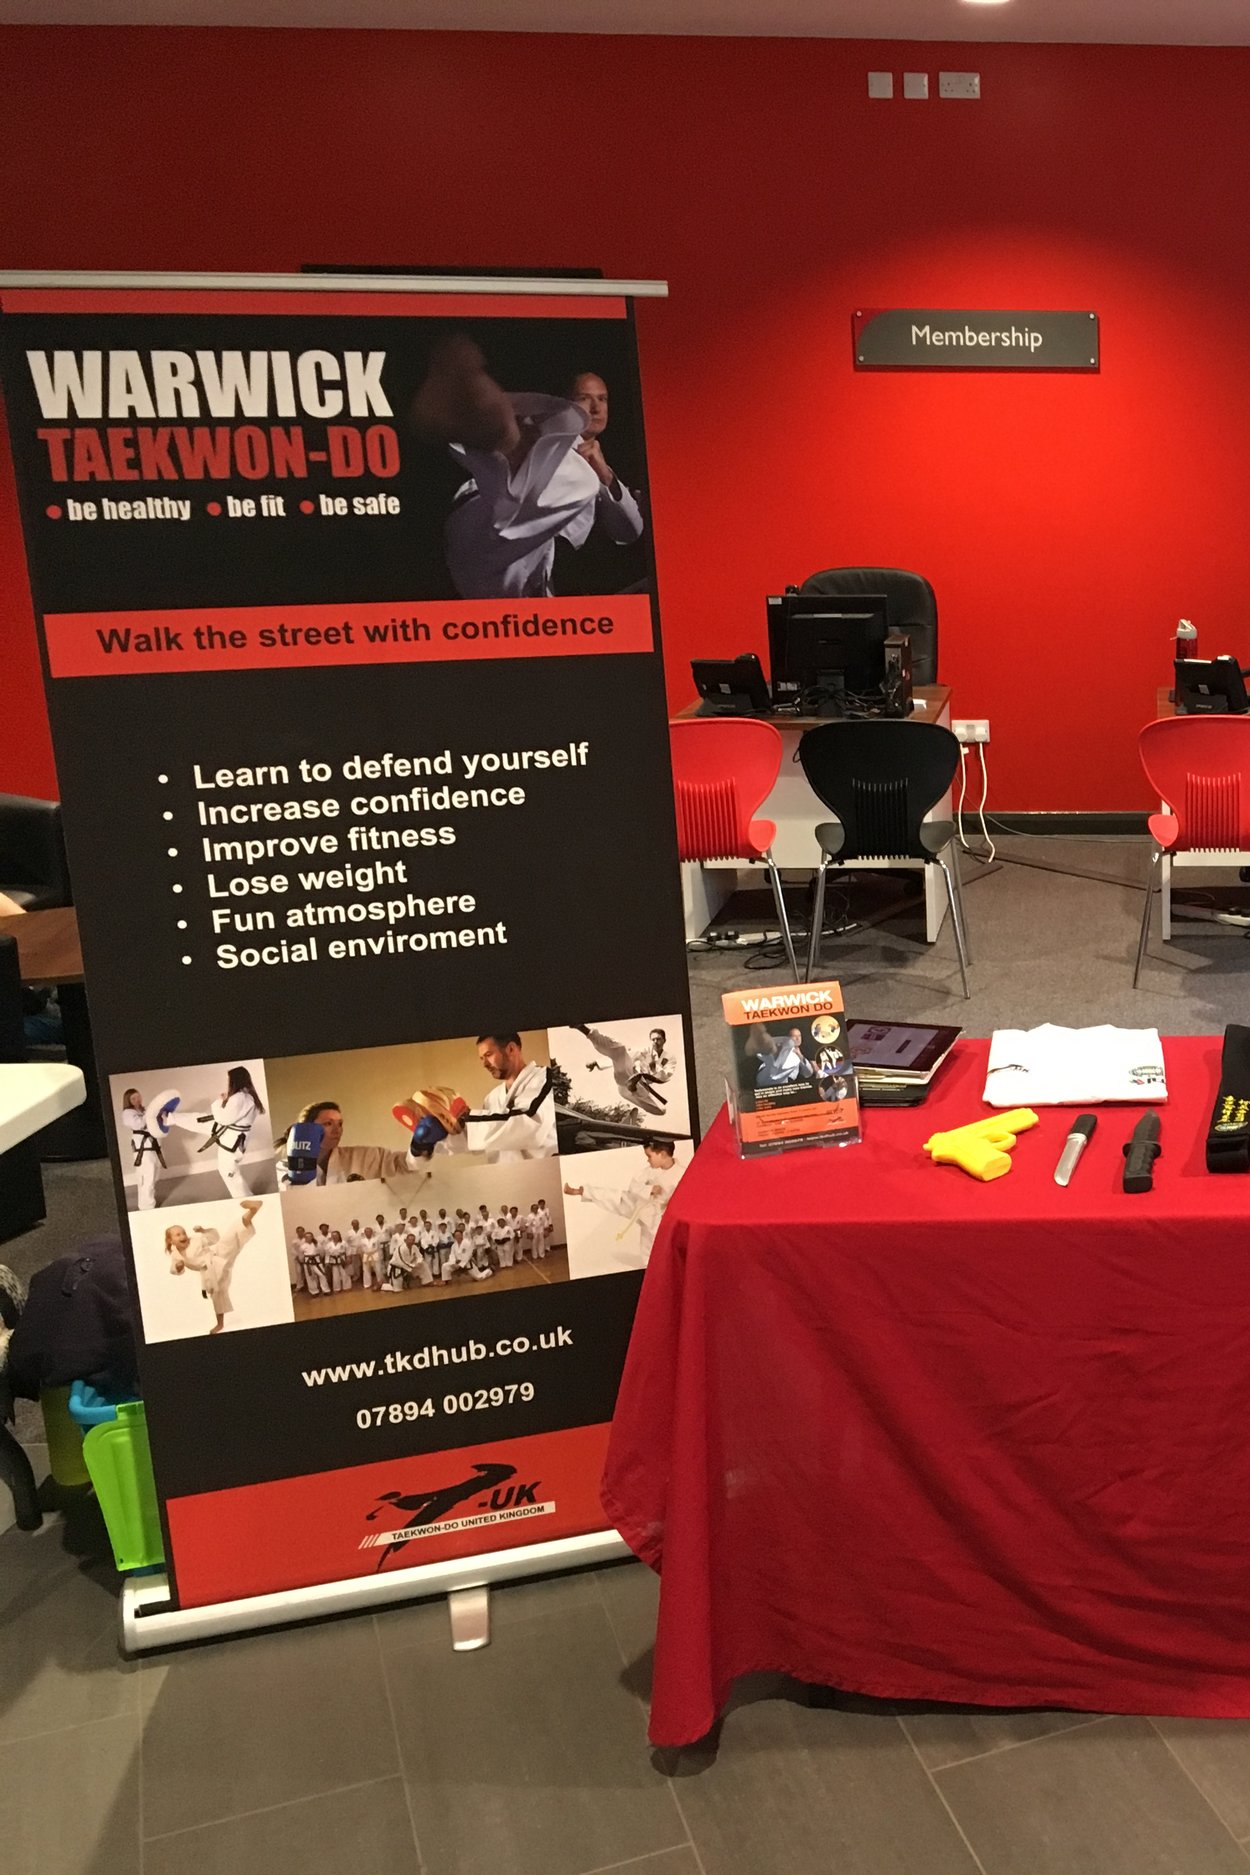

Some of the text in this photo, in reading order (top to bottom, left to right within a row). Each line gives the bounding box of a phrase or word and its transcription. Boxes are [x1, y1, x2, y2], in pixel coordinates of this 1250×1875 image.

[911, 325, 1043, 353] Membership
[26, 350, 394, 419] WARWICK
[37, 425, 400, 482] TAEKWON-DO
[66, 496, 191, 521] be healthy
[226, 494, 286, 518] be fit
[319, 493, 401, 516] be safe
[96, 613, 614, 654] Walk the street with confidence
[193, 742, 589, 789] Learn to defend yourself
[198, 784, 526, 826] Increase confidence
[203, 824, 456, 865] Improve fitness
[207, 859, 408, 898] Lose weight
[212, 893, 476, 934] Fun atmosphere
[216, 921, 508, 970] Social enviroment
[741, 990, 832, 1011] WARWICK
[743, 1002, 832, 1020] TAEKWON DO
[301, 1325, 573, 1387] www.tkdhub.co.uk
[356, 1382, 535, 1429] 07894 002979
[391, 1505, 545, 1541] TAEKWON-DO UNITED KINGDOM
